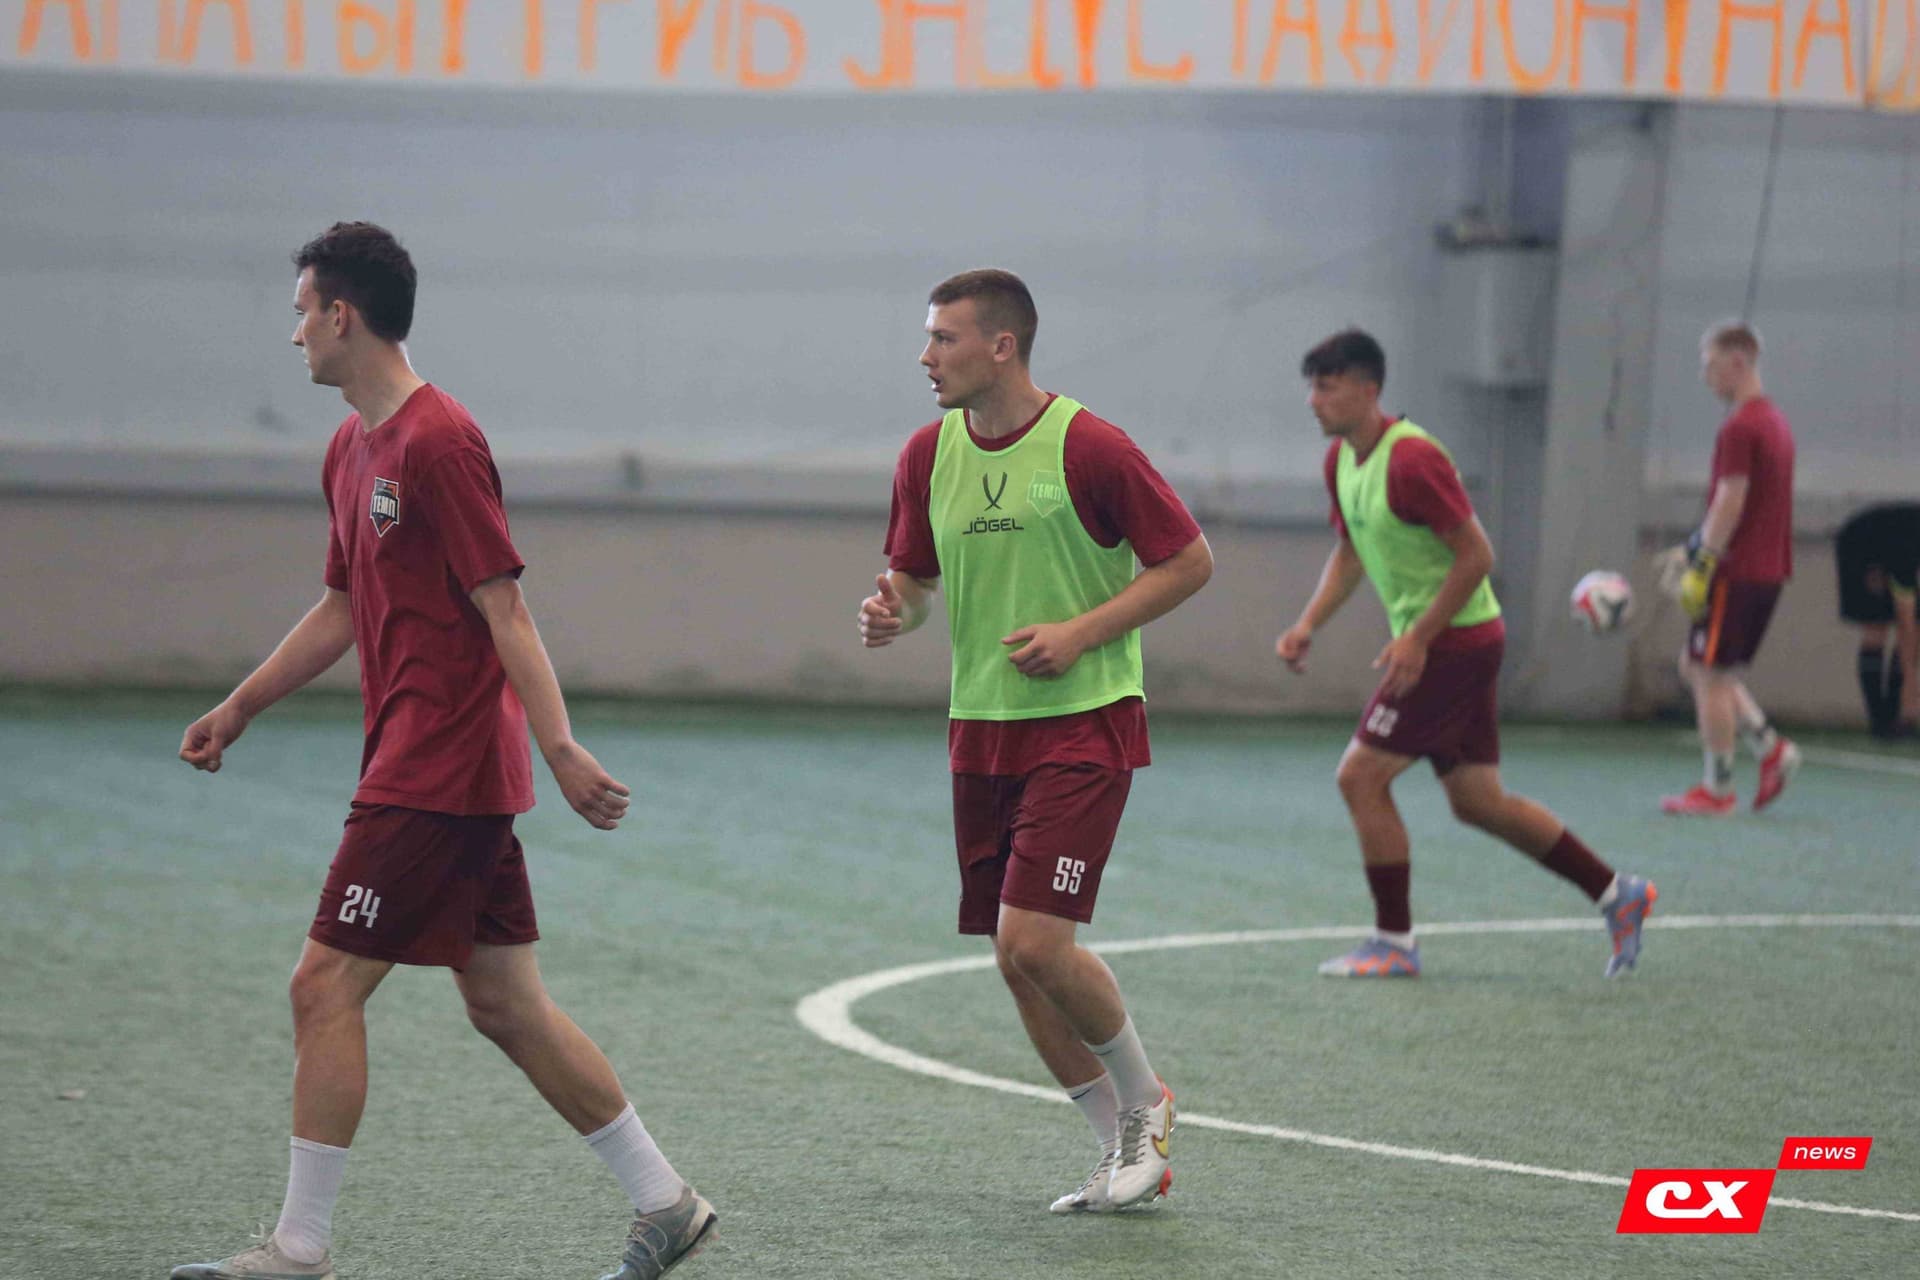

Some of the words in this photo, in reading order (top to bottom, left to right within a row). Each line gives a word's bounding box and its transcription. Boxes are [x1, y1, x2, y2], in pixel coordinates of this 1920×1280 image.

[962, 516, 1025, 535] JÖGEL
[1052, 855, 1086, 895] 55
[338, 884, 381, 928] 24
